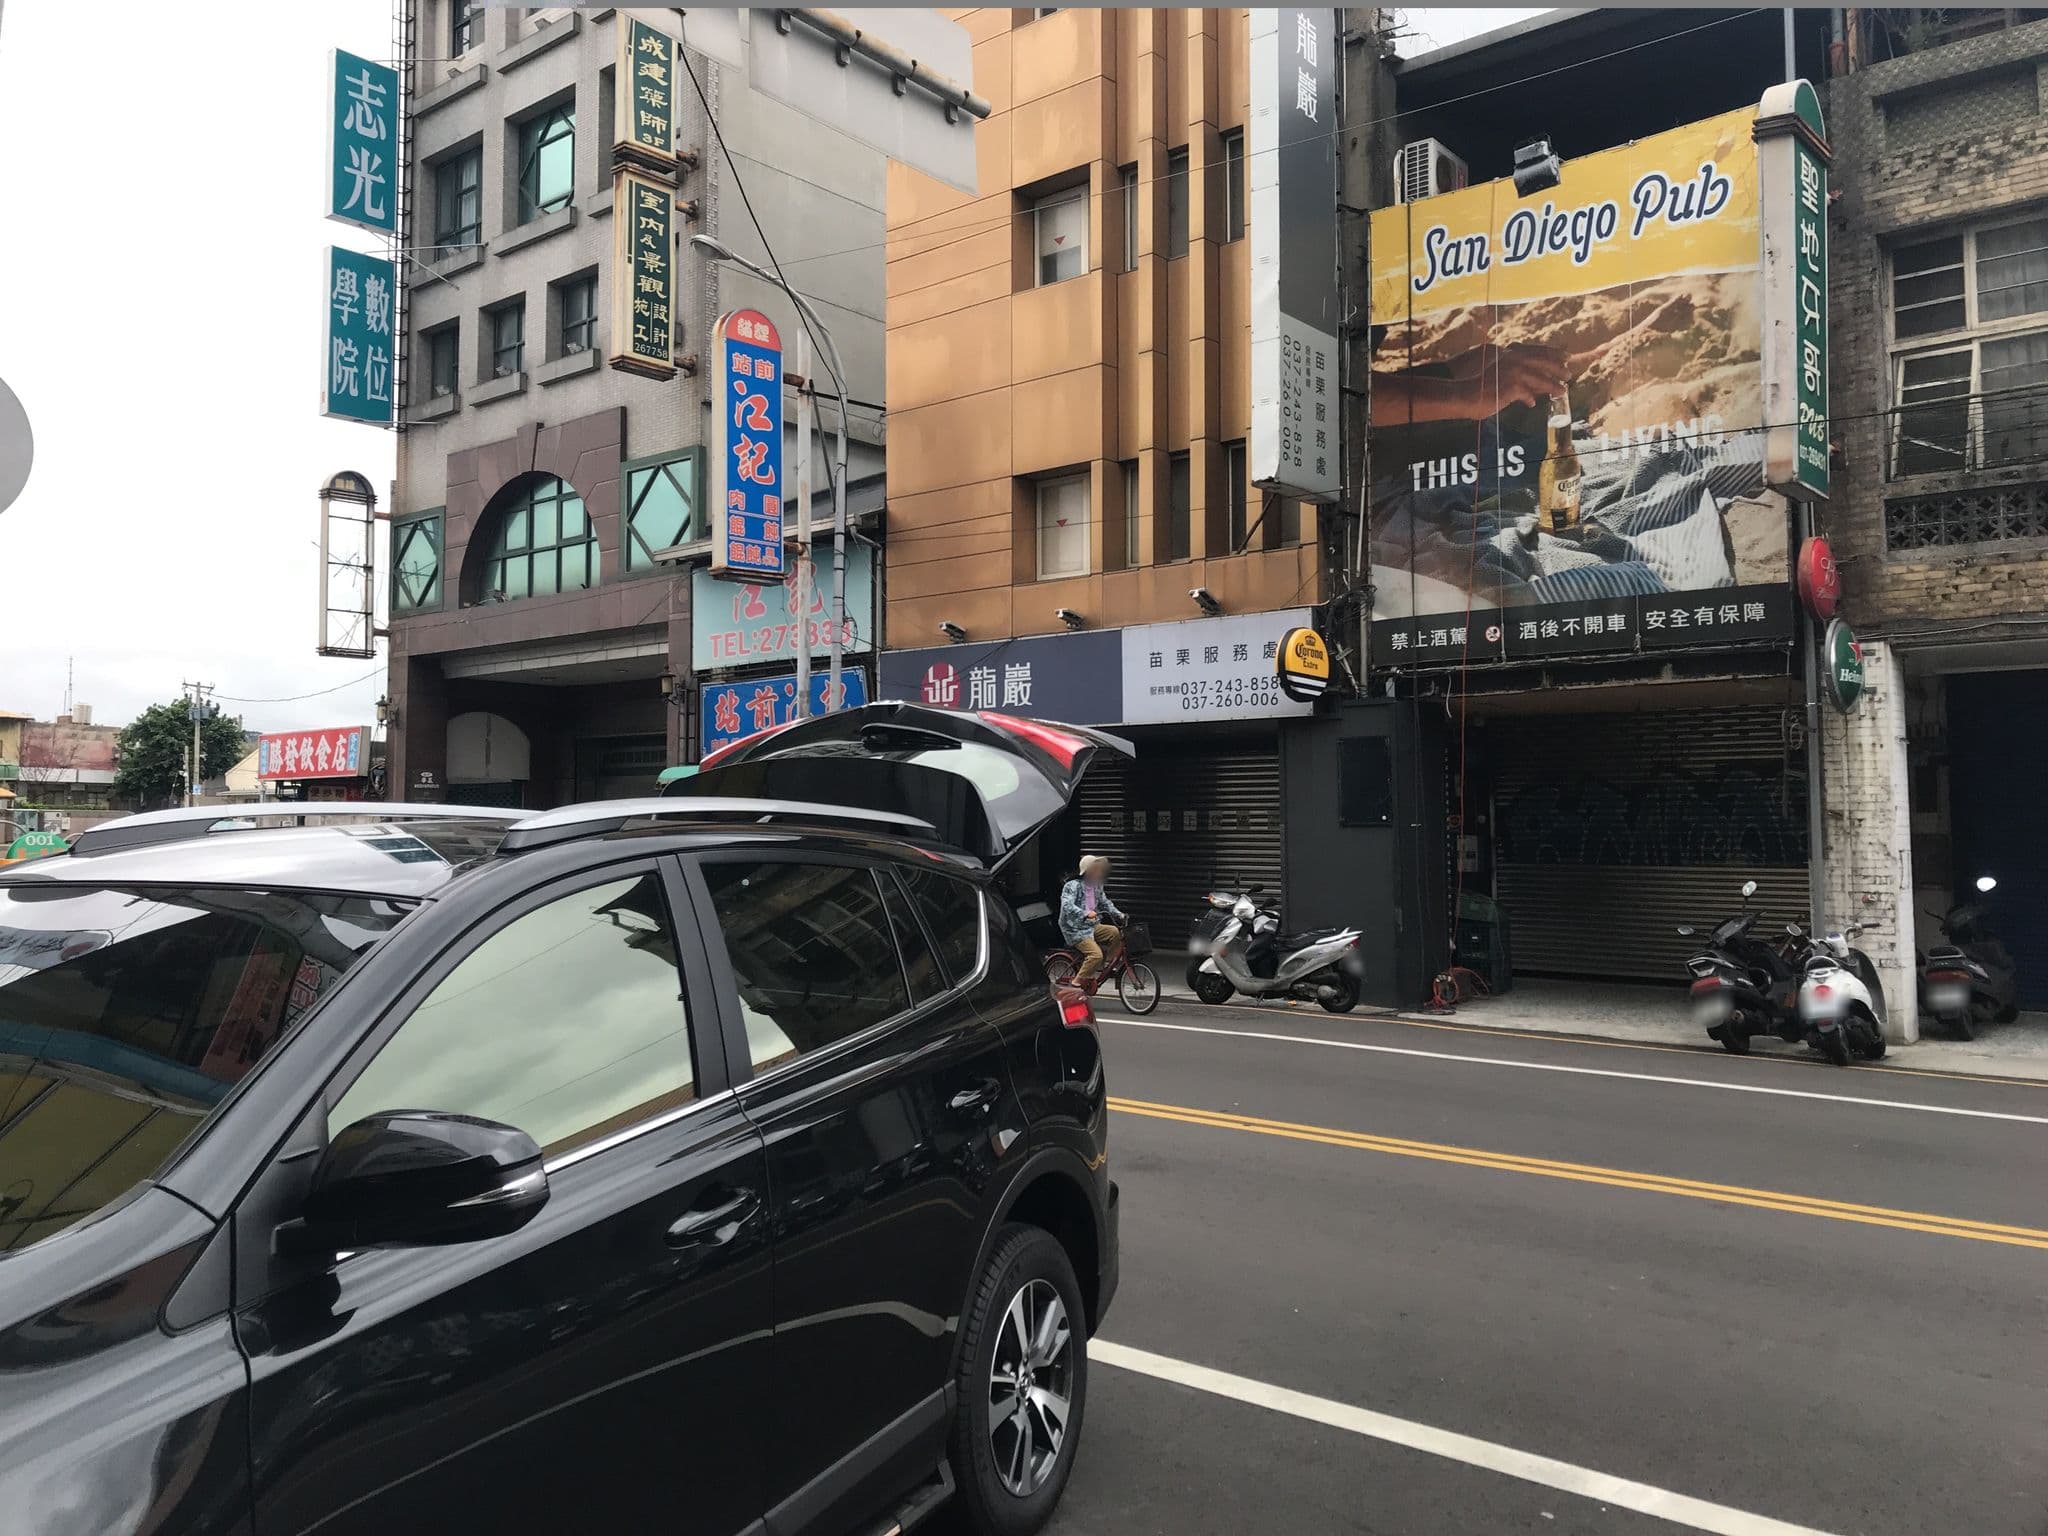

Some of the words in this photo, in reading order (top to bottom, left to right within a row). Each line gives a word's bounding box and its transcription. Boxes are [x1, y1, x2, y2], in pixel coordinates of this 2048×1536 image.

[1296, 13, 1318, 123] 龍巖
[343, 69, 387, 220] 志光
[642, 133, 665, 147] 3F
[1414, 227, 1492, 291] San
[1503, 203, 1616, 263] Diego
[1633, 163, 1729, 236] Pub
[333, 266, 360, 397] 學院
[364, 273, 390, 402] 數位
[634, 297, 650, 342] 施工
[653, 303, 668, 347] 設計
[732, 352, 775, 381] 站前
[733, 380, 776, 485] 江記
[1409, 453, 1479, 492] THIS
[1497, 445, 1525, 478] IS
[1600, 414, 1725, 463] LIVING
[1391, 626, 1468, 650] 禁止酒駕
[1519, 614, 1628, 640] 酒後不開車
[1645, 602, 1767, 630] 安全有保障
[1149, 641, 1278, 668] 苗栗服務處
[1295, 642, 1324, 660] Corona
[968, 662, 1033, 710] 龍巖
[1181, 676, 1280, 696] 037-243-858
[1182, 692, 1279, 710] 037-260-006
